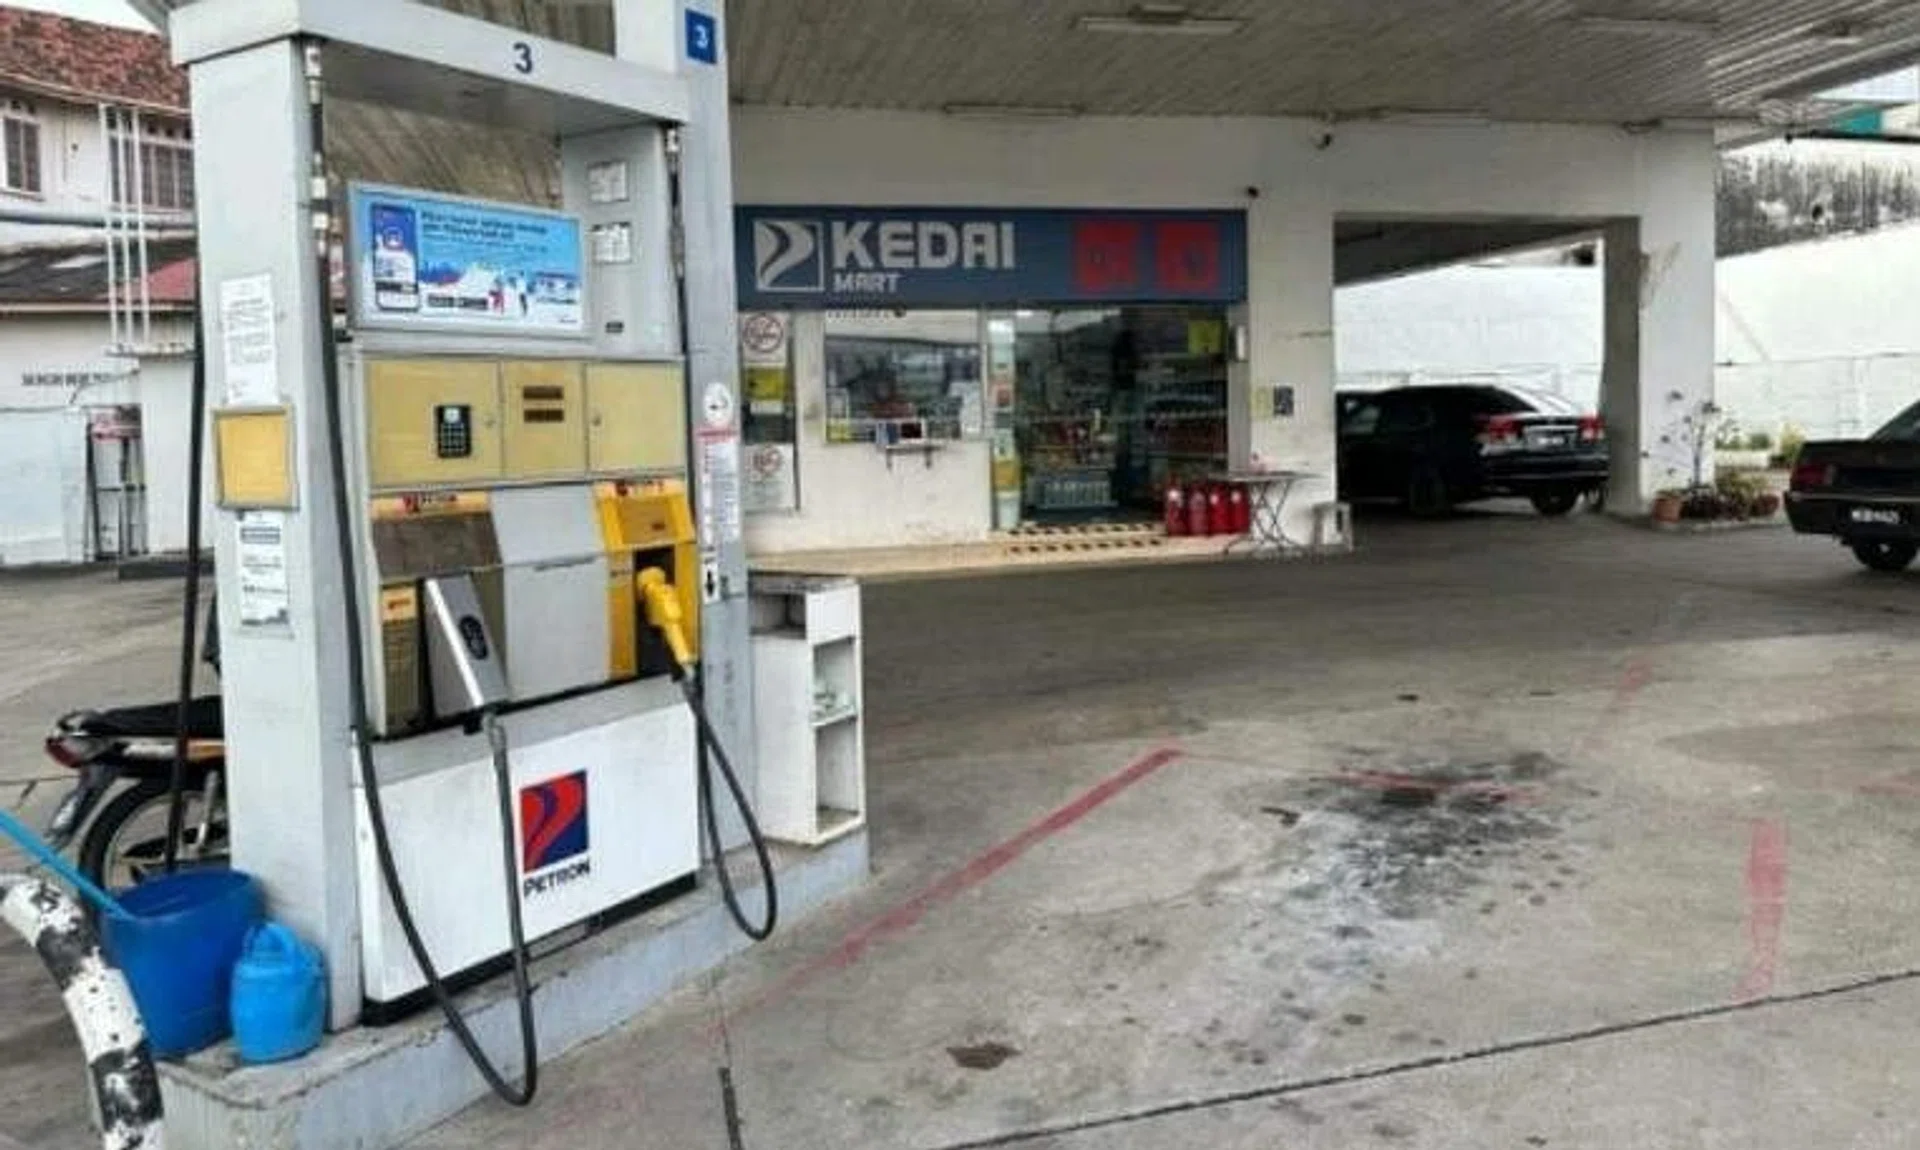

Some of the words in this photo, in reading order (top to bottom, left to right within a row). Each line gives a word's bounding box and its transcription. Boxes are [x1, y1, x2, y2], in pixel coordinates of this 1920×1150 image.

[695, 25, 709, 49] 3
[513, 42, 533, 74] 3
[830, 221, 1015, 269] KEDAI
[833, 272, 899, 293] MART
[523, 858, 591, 898] PETRON
